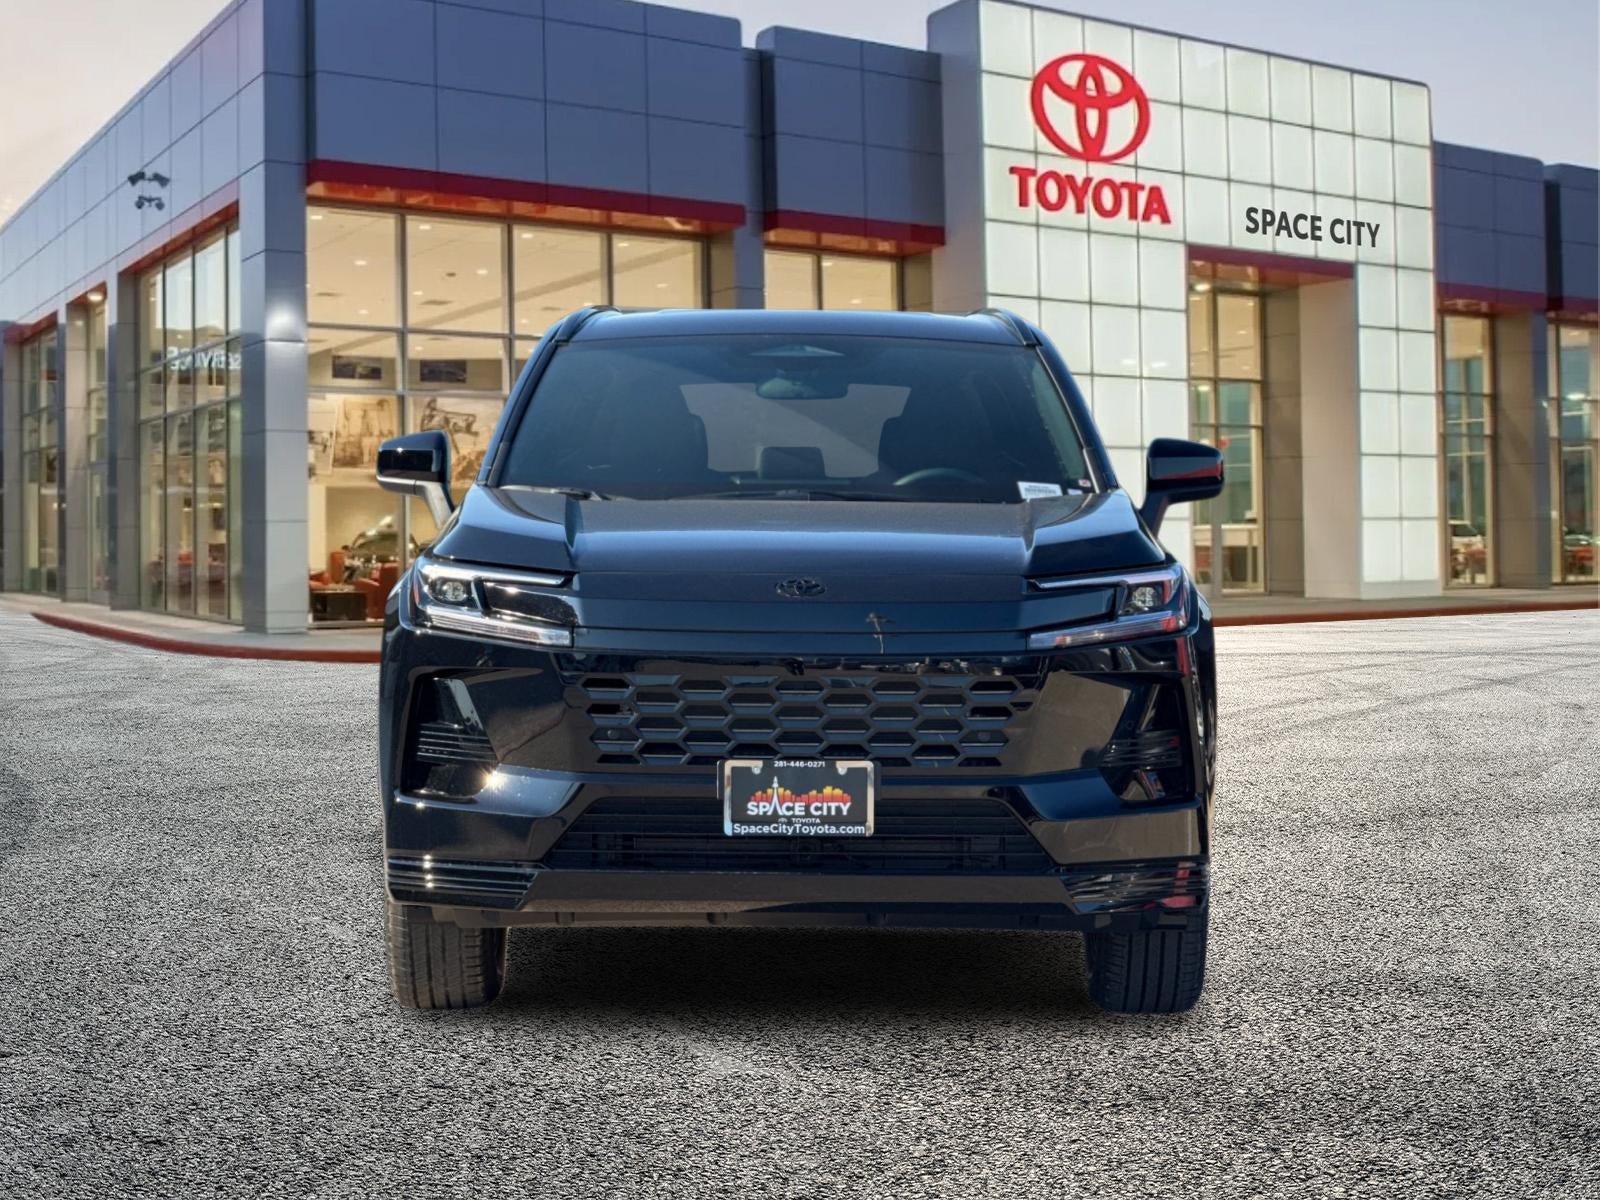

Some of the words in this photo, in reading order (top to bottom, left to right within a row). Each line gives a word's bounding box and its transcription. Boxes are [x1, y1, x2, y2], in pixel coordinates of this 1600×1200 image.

[1009, 166, 1171, 225] TOYOTA
[1245, 206, 1322, 242] SPACE
[1329, 217, 1381, 248] CITY
[773, 760, 826, 768] 281-446-0271
[746, 800, 805, 816] SPACE
[810, 801, 852, 816] CITY
[733, 823, 866, 835] SpaceCityToyota.com
